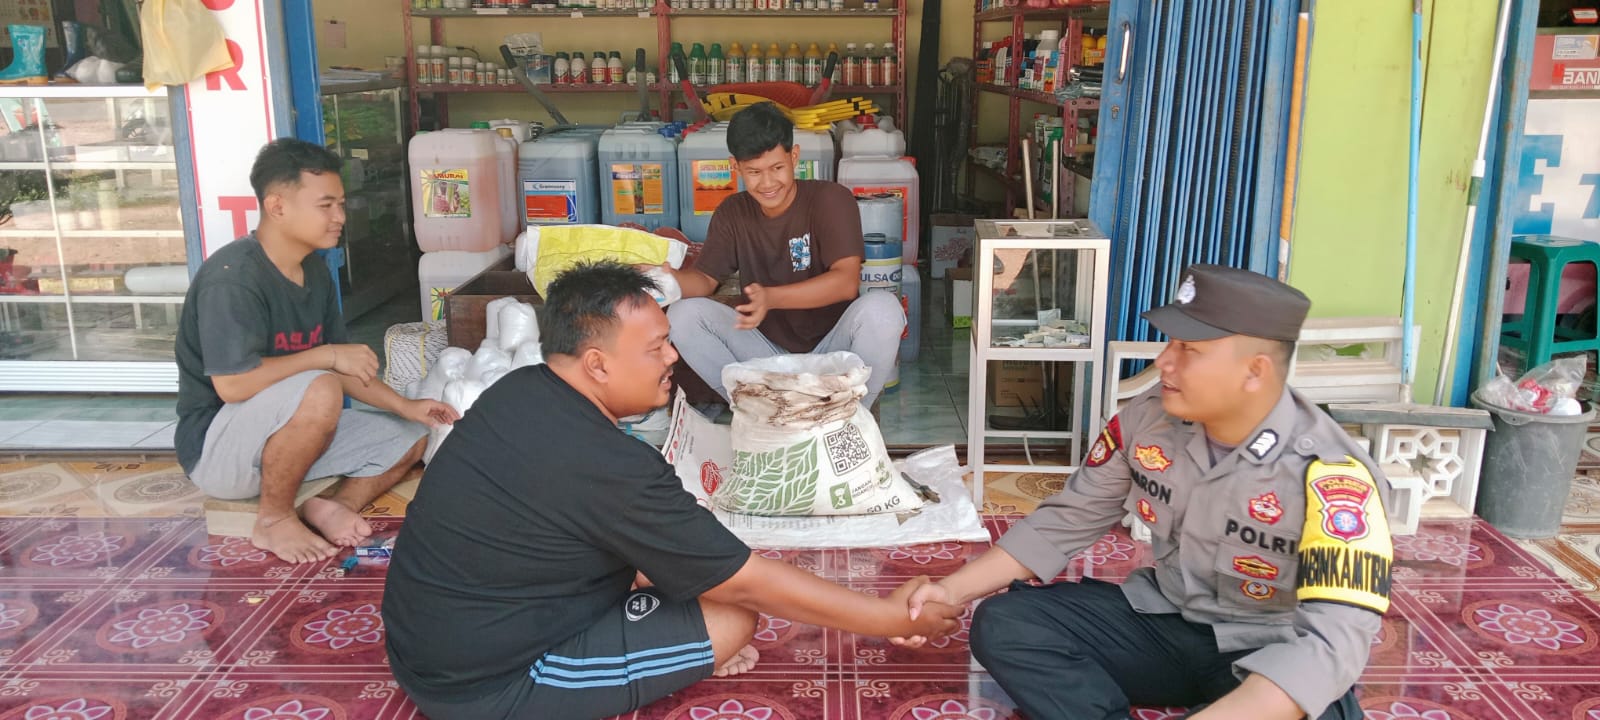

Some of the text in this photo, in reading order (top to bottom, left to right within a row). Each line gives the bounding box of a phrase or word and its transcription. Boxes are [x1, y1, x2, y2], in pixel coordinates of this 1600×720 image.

[1562, 71, 1600, 85] BAN
[884, 495, 901, 510] KG
[1224, 518, 1296, 555] POLRI
